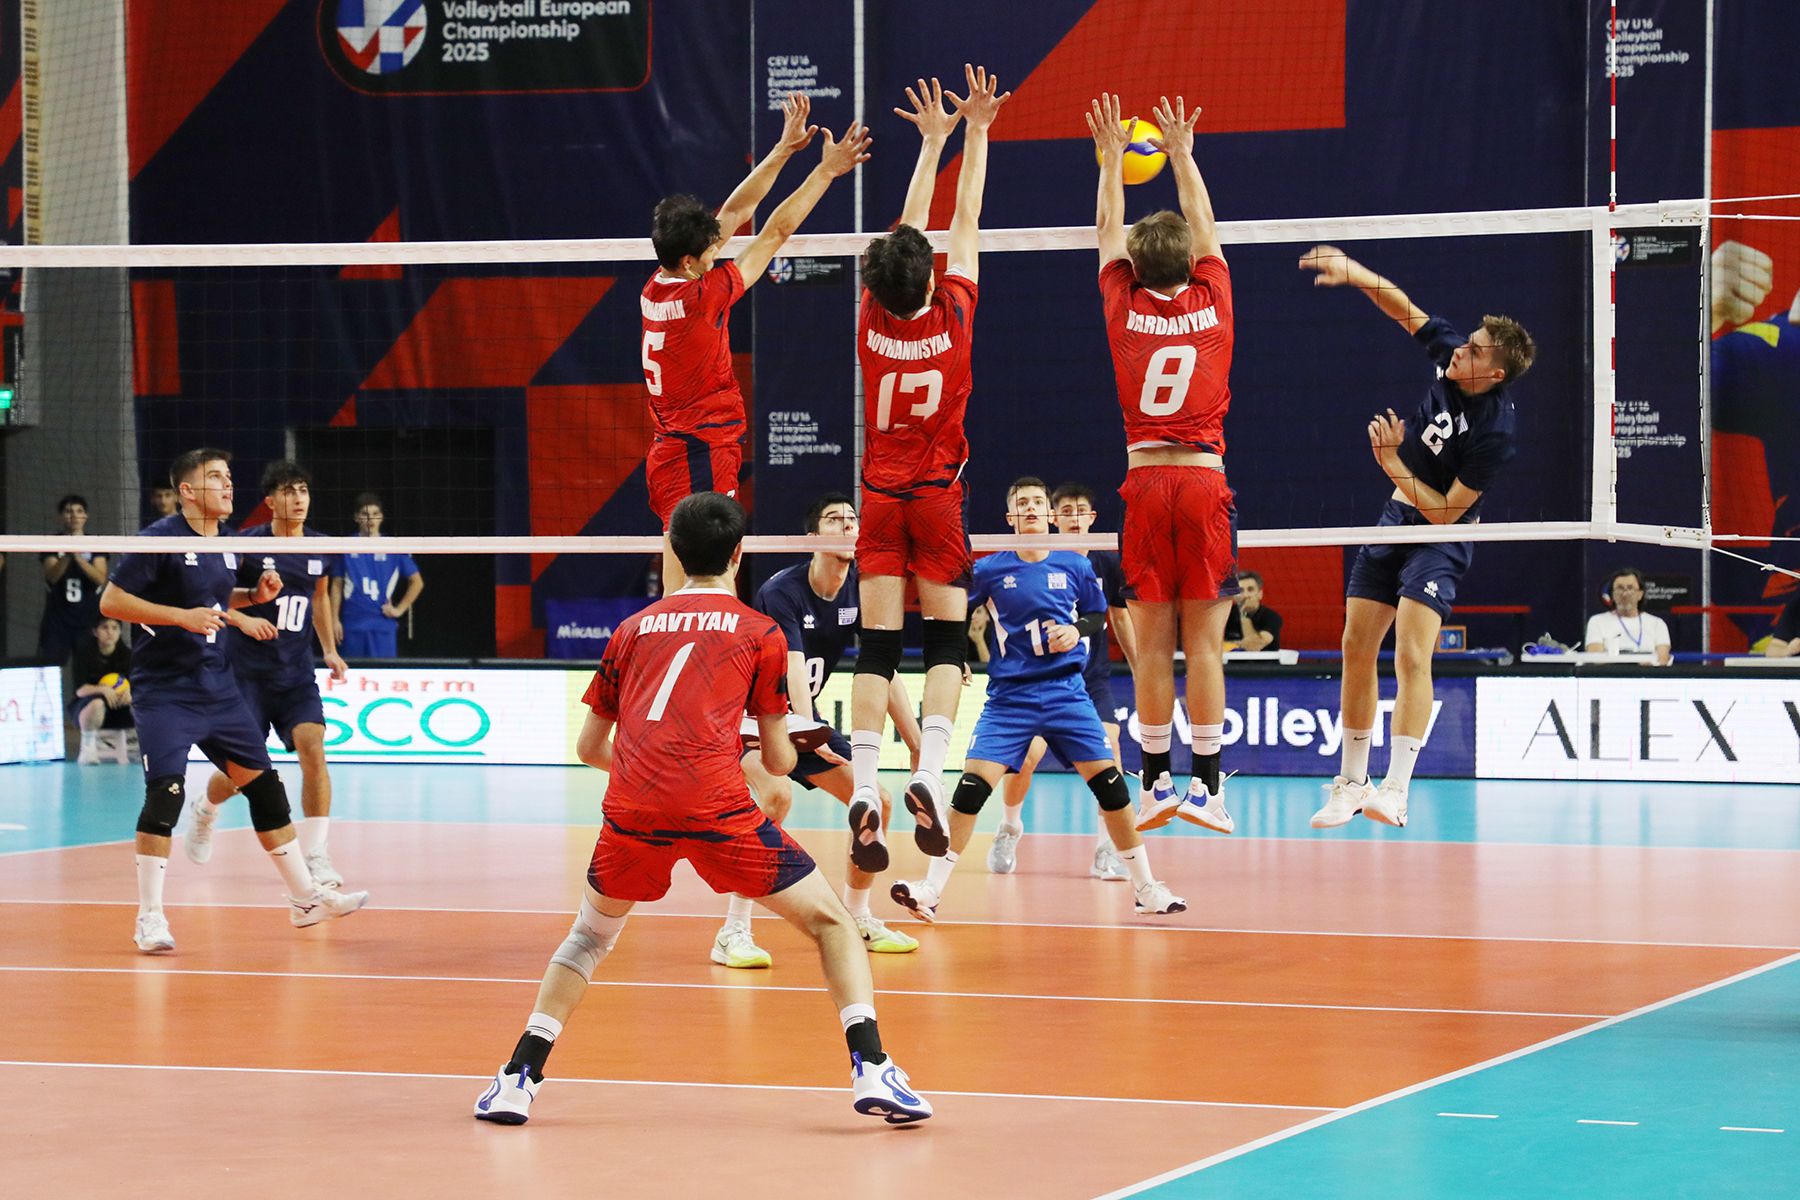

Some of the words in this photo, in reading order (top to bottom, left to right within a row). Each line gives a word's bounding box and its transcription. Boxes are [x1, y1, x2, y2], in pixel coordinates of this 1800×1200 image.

[442, 0, 535, 22] Volleyball
[540, 0, 631, 20] European
[442, 19, 581, 42] Championship
[442, 43, 490, 62] 2025
[642, 330, 666, 396] 5
[1139, 345, 1197, 416] 8
[1421, 411, 1453, 456] 2
[362, 576, 380, 601] 4
[275, 595, 309, 632] 10
[639, 611, 740, 636] DAVTYAN
[646, 642, 696, 721] 1
[322, 697, 491, 747] SCO
[1521, 698, 1739, 762] ALEX
